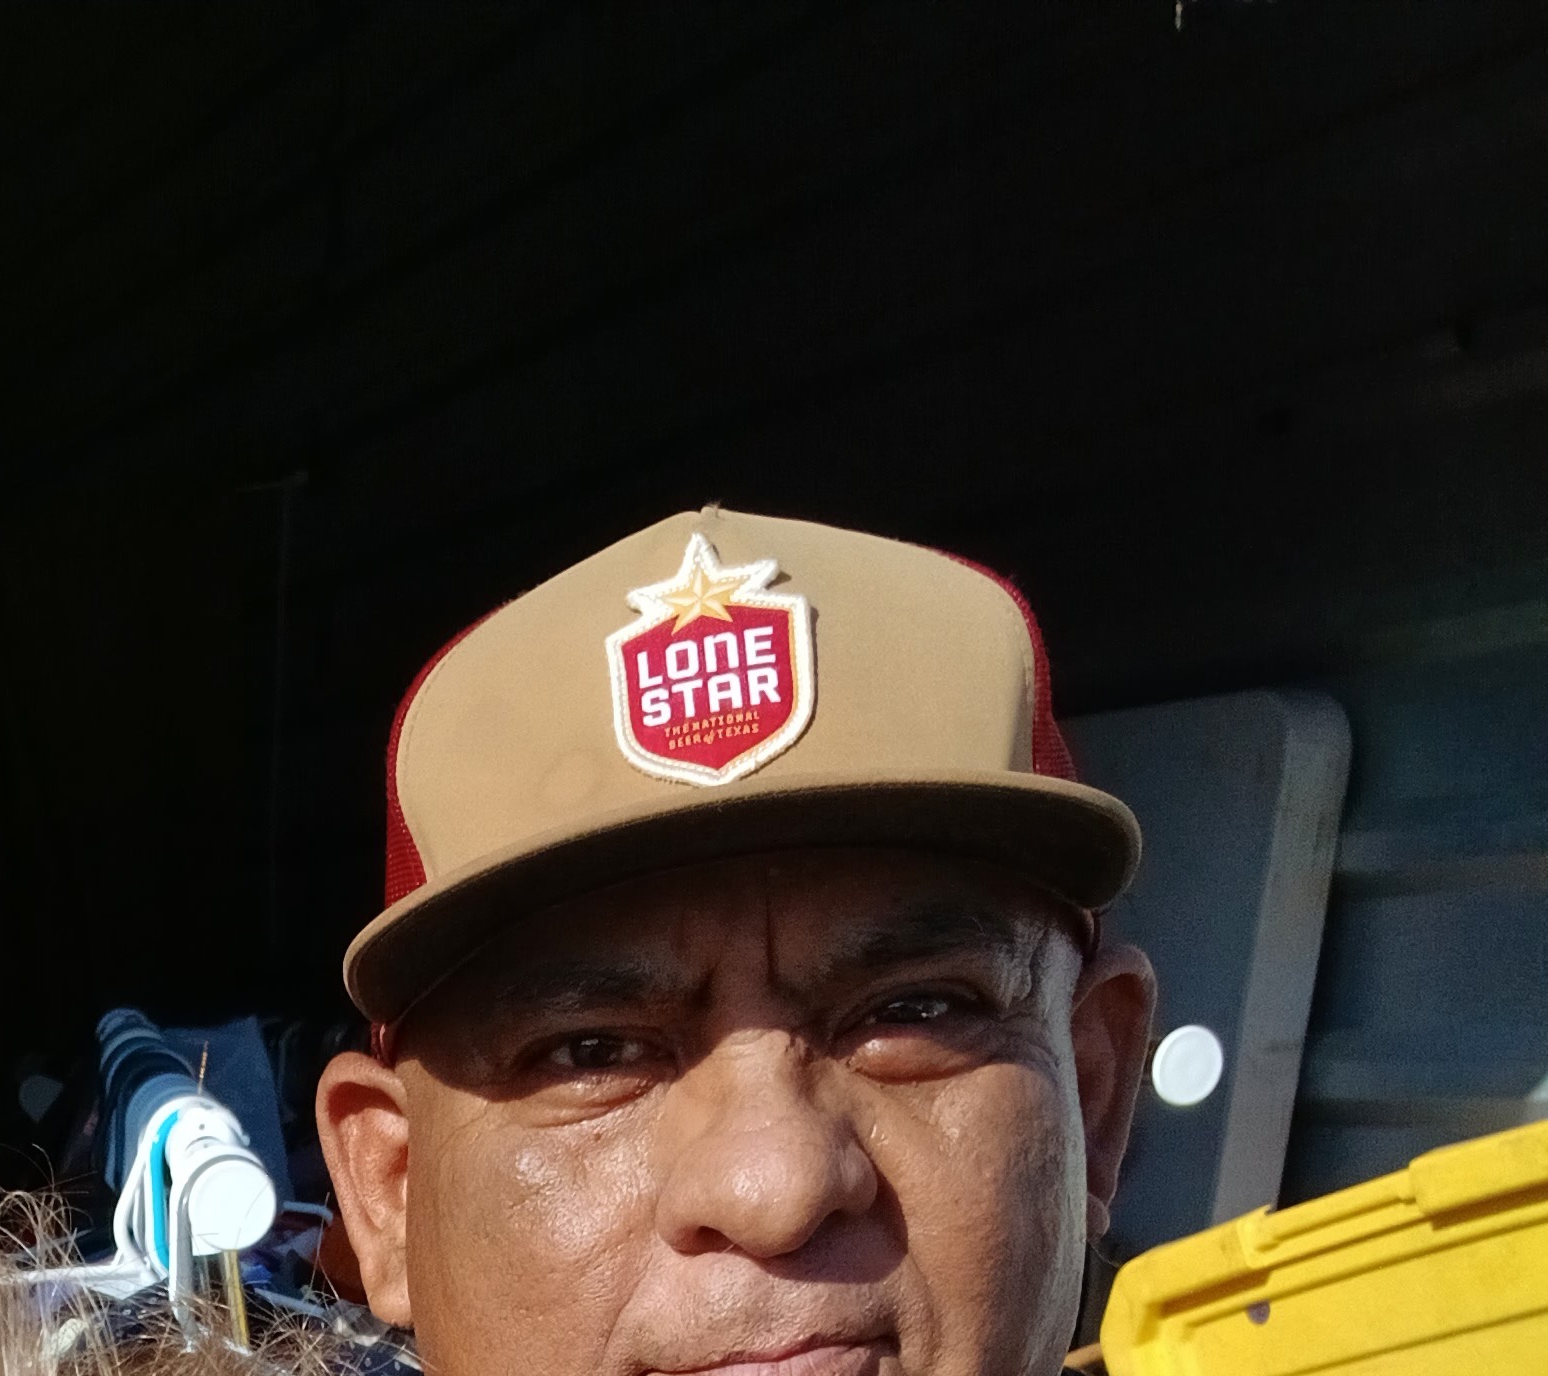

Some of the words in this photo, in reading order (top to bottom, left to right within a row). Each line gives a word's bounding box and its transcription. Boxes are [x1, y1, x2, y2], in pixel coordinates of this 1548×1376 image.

[637, 626, 776, 689] LONE
[641, 667, 781, 727] STAR
[664, 722, 689, 737] THE
[692, 711, 759, 731] NATIONAL
[668, 733, 701, 750] BEER
[717, 723, 759, 738] TEXAS
